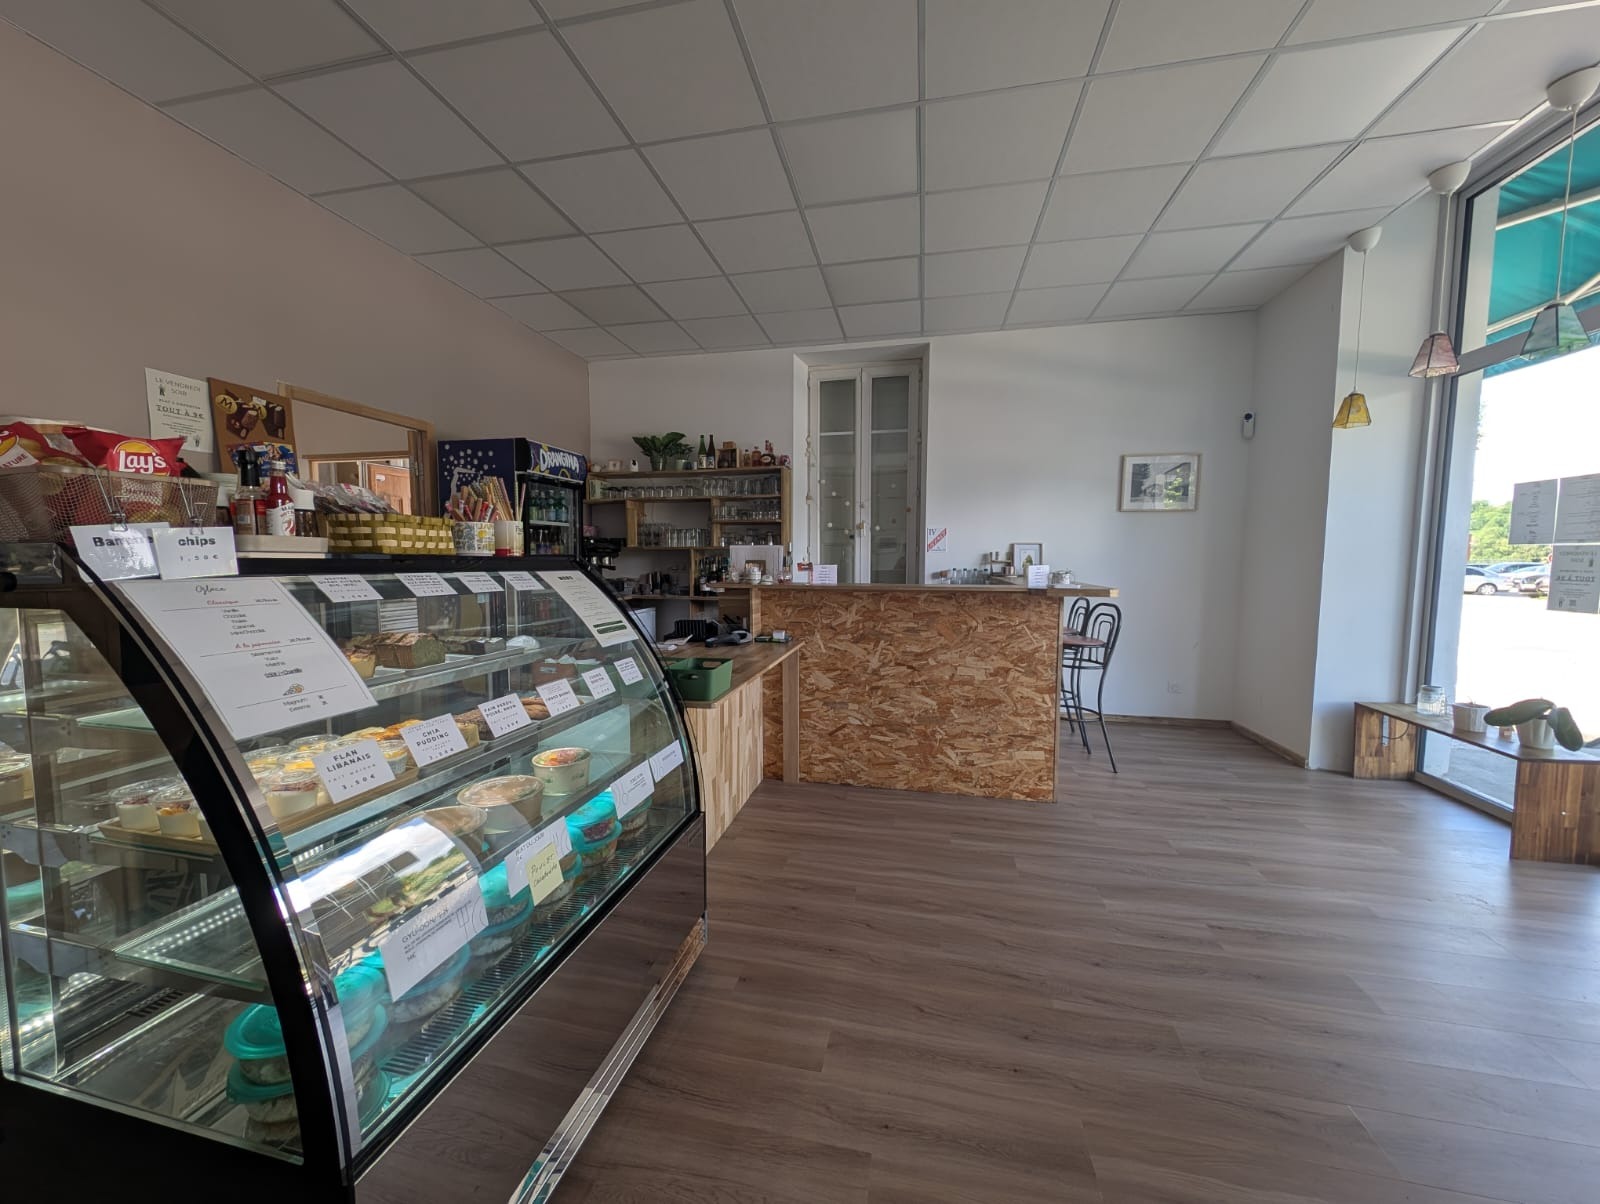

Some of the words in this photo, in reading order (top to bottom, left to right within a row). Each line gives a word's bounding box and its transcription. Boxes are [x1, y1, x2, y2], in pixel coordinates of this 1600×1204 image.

[119, 450, 167, 474] Lay's
[178, 535, 216, 547] chips
[416, 732, 450, 747] PUDDING
[422, 728, 441, 738] CHIA
[333, 749, 359, 762] FLAN
[326, 753, 372, 773] LIBANAIS
